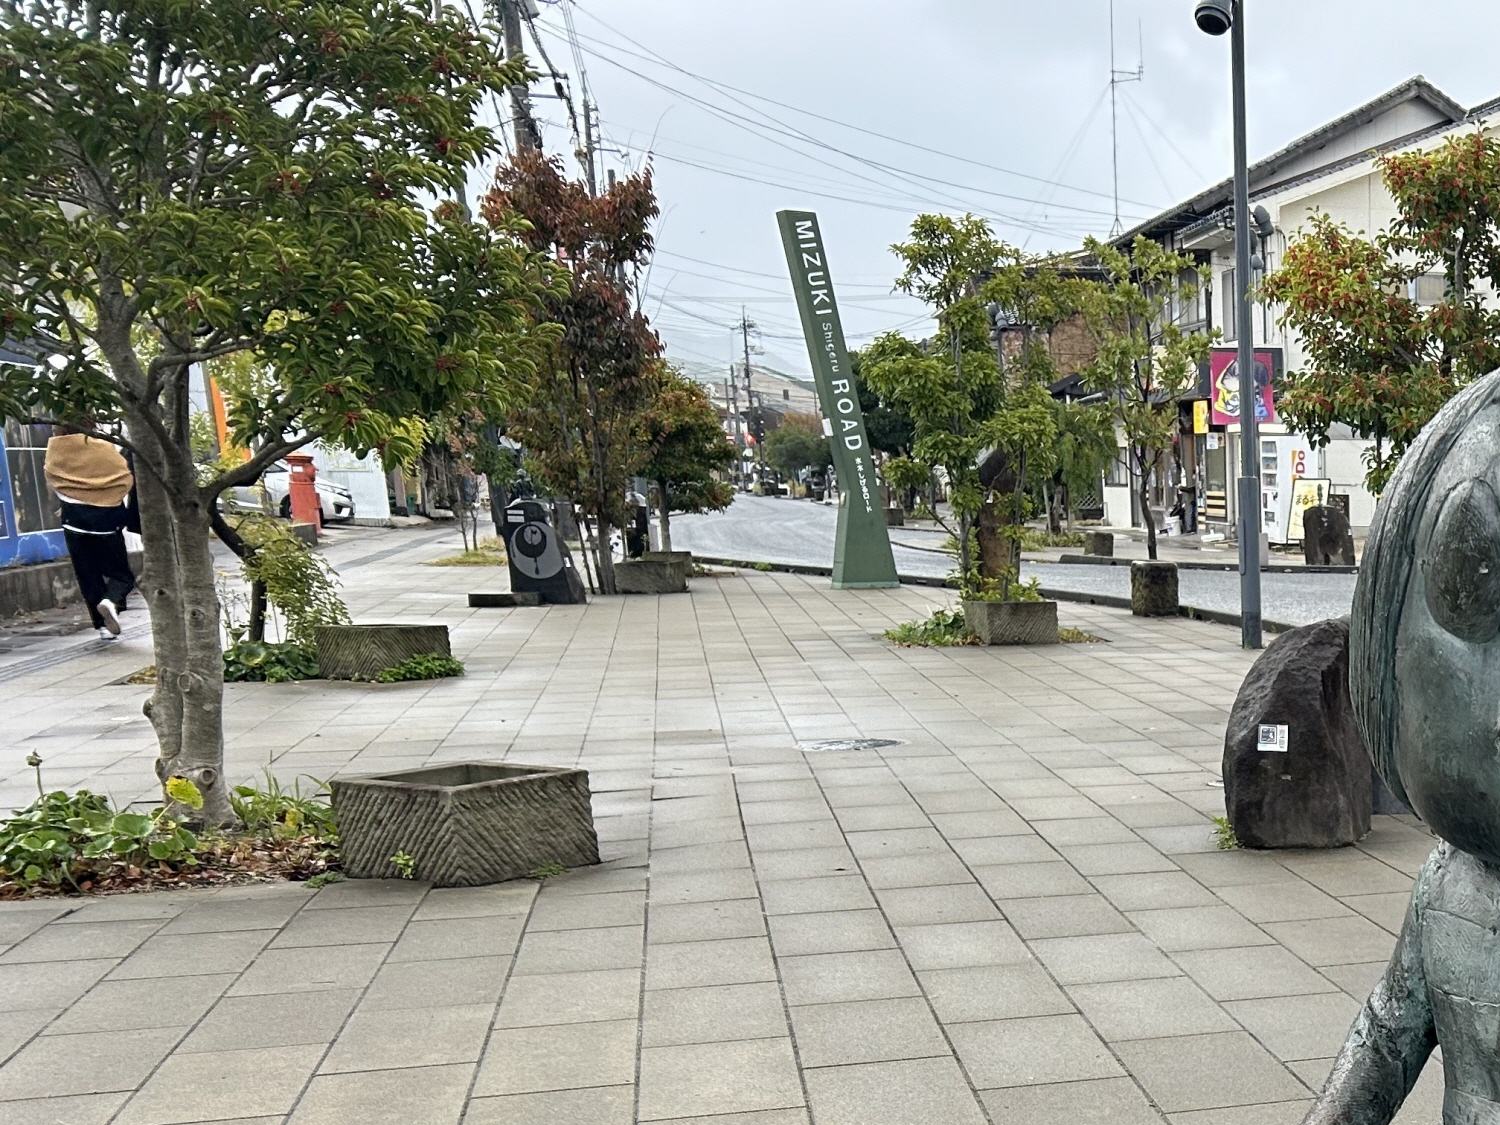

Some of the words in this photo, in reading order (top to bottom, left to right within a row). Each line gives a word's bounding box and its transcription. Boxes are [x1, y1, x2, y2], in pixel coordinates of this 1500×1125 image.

[795, 220, 832, 315] MIZUKI
[822, 322, 840, 373] Shigeru
[832, 378, 863, 451] ROAD
